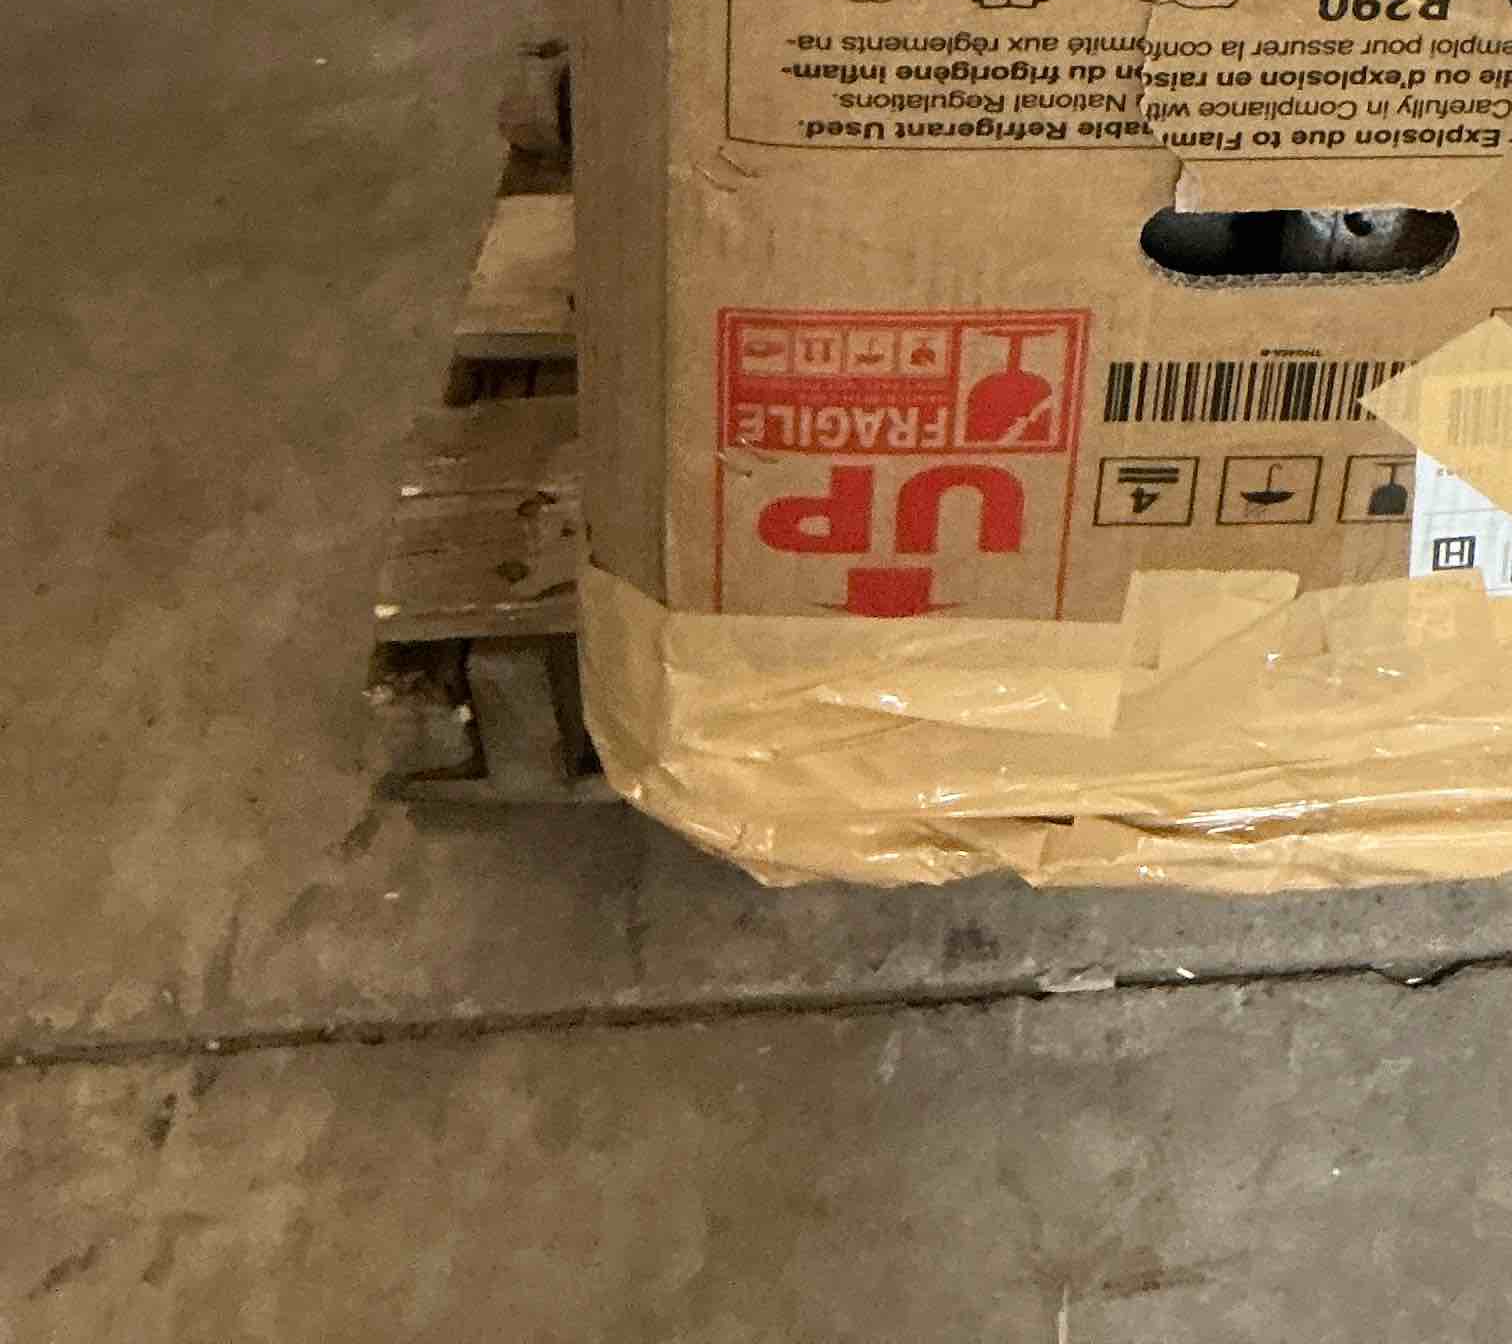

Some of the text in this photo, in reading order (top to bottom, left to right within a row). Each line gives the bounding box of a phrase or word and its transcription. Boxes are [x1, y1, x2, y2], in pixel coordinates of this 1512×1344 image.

[785, 34, 832, 53] na-
[841, 32, 999, 58] règlements
[1007, 35, 1059, 54] aux
[1068, 35, 1213, 61] conformité
[1221, 41, 1245, 62] la
[1250, 39, 1354, 59] assurer
[1361, 35, 1423, 57] pour
[781, 62, 886, 85] inflam-
[895, 60, 1060, 86] frigorigène
[1069, 65, 1106, 85] du
[1115, 64, 1207, 90] raison
[1216, 70, 1252, 86] en
[1435, 68, 1471, 86] ou
[832, 90, 1005, 114] Regulations.
[1014, 92, 1126, 113] National
[1199, 97, 1358, 121] Compliance
[1366, 99, 1389, 120] in
[1397, 95, 1512, 120] Carefully
[798, 120, 884, 141] Used.
[894, 117, 1067, 141] Refrigerant
[1252, 130, 1281, 148] to
[1292, 129, 1345, 149] due
[1356, 124, 1501, 149] Explosion
[733, 402, 947, 448] FRAGILE
[757, 464, 1023, 556] UP
